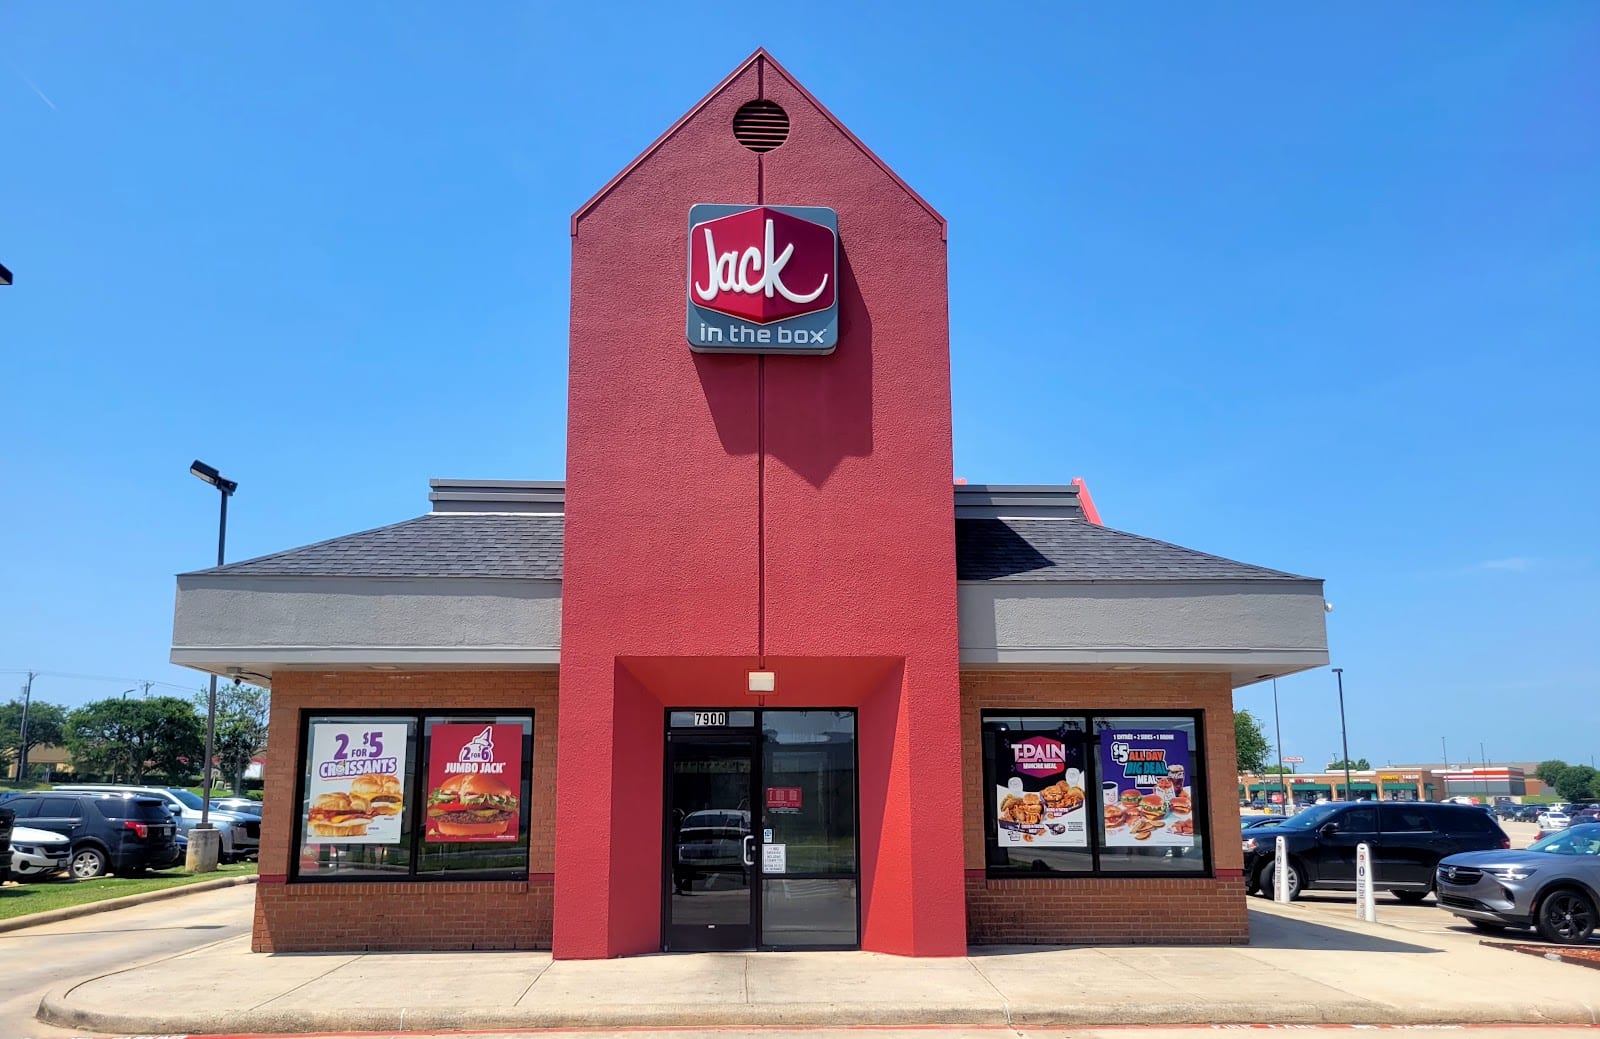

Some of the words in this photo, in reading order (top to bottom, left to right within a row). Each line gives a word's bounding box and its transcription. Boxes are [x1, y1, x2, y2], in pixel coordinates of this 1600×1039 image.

[695, 219, 829, 304] Jack
[700, 323, 723, 342] in
[729, 325, 771, 343] the
[778, 326, 827, 344] box
[695, 712, 725, 726] 7900
[334, 733, 350, 760] 2
[351, 749, 368, 758] FOR
[363, 731, 384, 758] $5
[1112, 743, 1129, 763] $5
[463, 746, 472, 761] 2
[1128, 751, 1145, 762] ALL
[1145, 751, 1164, 762] DAY
[444, 762, 479, 774] JUMBO
[1125, 761, 1143, 776] BIG
[1143, 761, 1168, 776] DEAL
